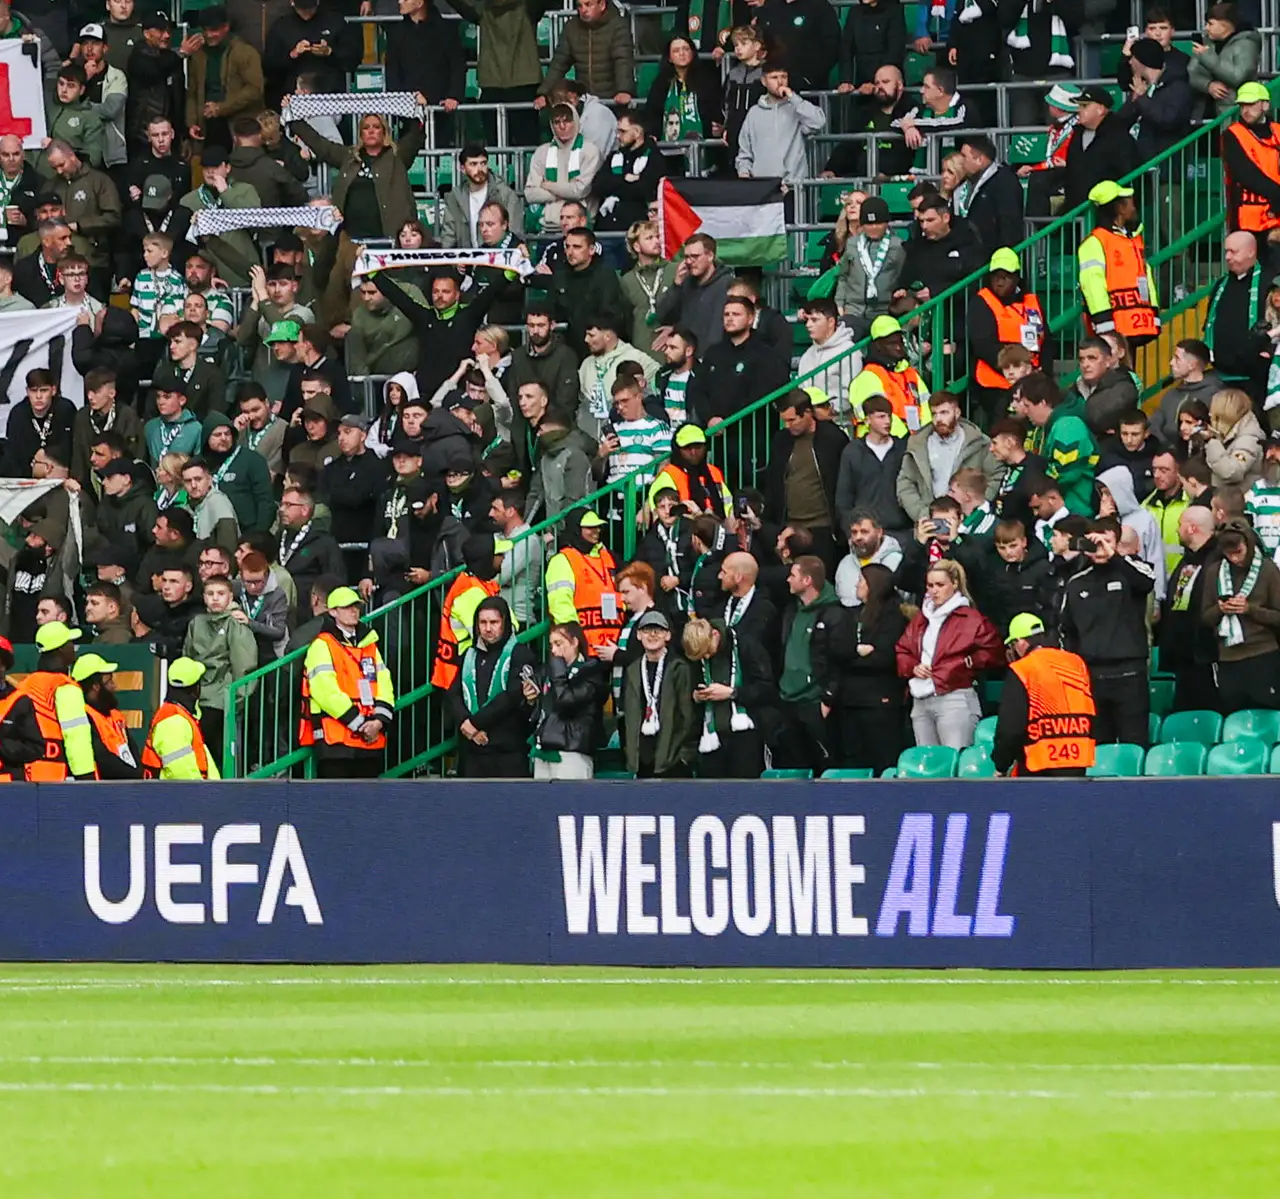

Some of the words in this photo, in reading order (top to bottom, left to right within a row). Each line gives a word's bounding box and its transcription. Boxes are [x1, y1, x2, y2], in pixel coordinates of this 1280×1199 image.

[390, 250, 486, 261] KNEECAP
[1046, 742, 1081, 762] 249
[83, 822, 324, 926] UEFA
[557, 814, 870, 938] WELCOME
[874, 811, 1018, 939] ALL
